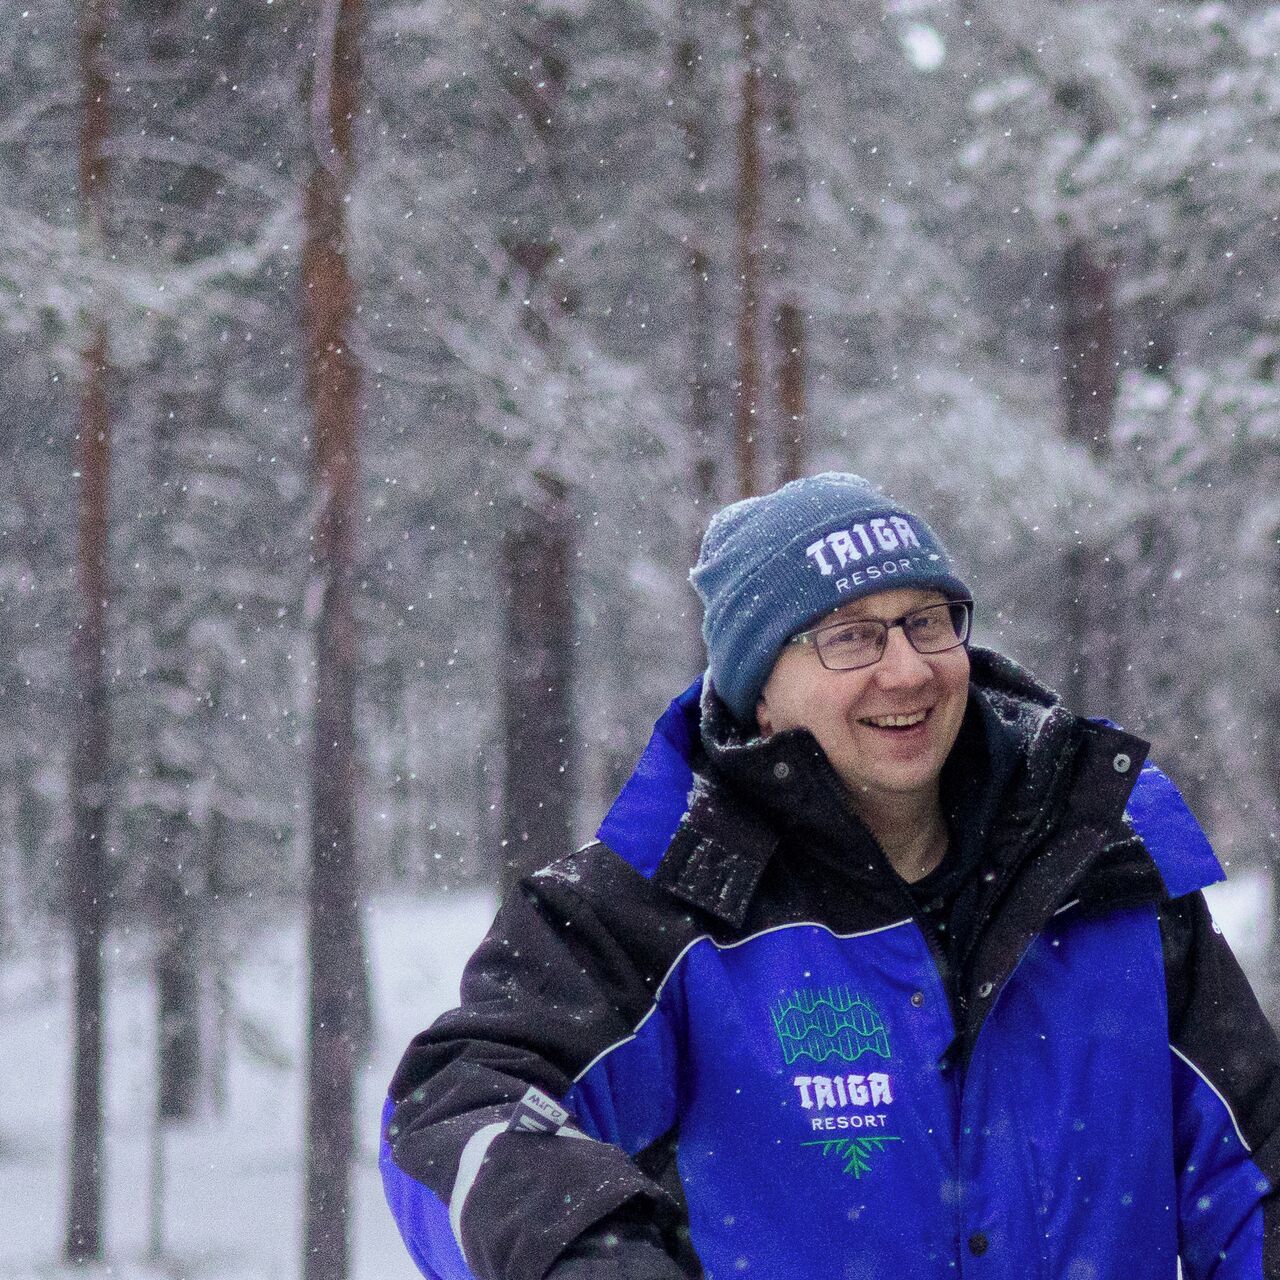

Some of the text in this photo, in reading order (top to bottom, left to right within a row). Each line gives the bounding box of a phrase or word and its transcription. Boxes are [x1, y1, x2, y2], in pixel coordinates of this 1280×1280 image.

[806, 515, 920, 575] TAIGA
[835, 557, 919, 593] RESORT
[793, 1071, 893, 1110] TAIGA
[812, 1115, 887, 1131] RESORT
